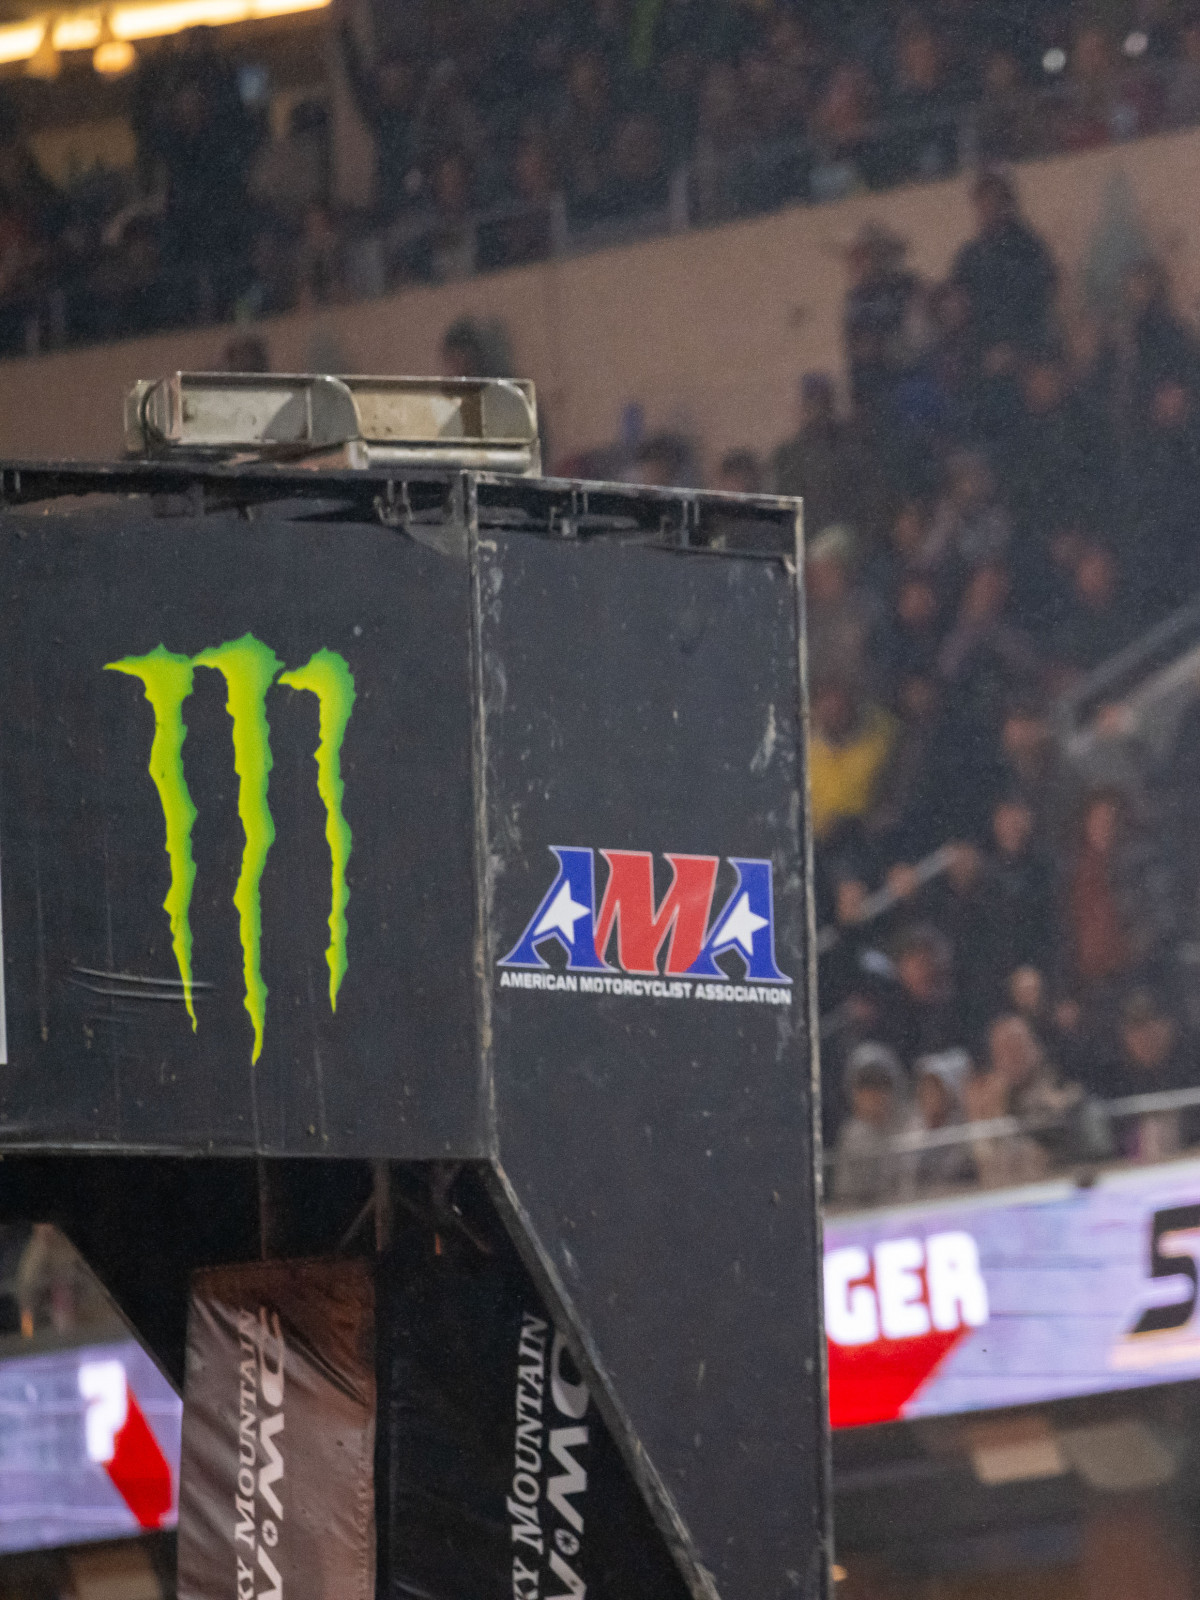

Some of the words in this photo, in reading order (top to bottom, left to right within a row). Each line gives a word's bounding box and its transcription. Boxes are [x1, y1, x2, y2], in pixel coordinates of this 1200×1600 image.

[496, 844, 794, 984] AMA
[500, 970, 578, 992] AMERICAN
[579, 975, 694, 999] MOTORCYCLIST
[694, 982, 792, 1005] ASSOCIATION
[824, 1230, 991, 1346] GER
[234, 1308, 257, 1551] MOUNTAIN
[505, 1312, 548, 1555] MOUNTAIN
